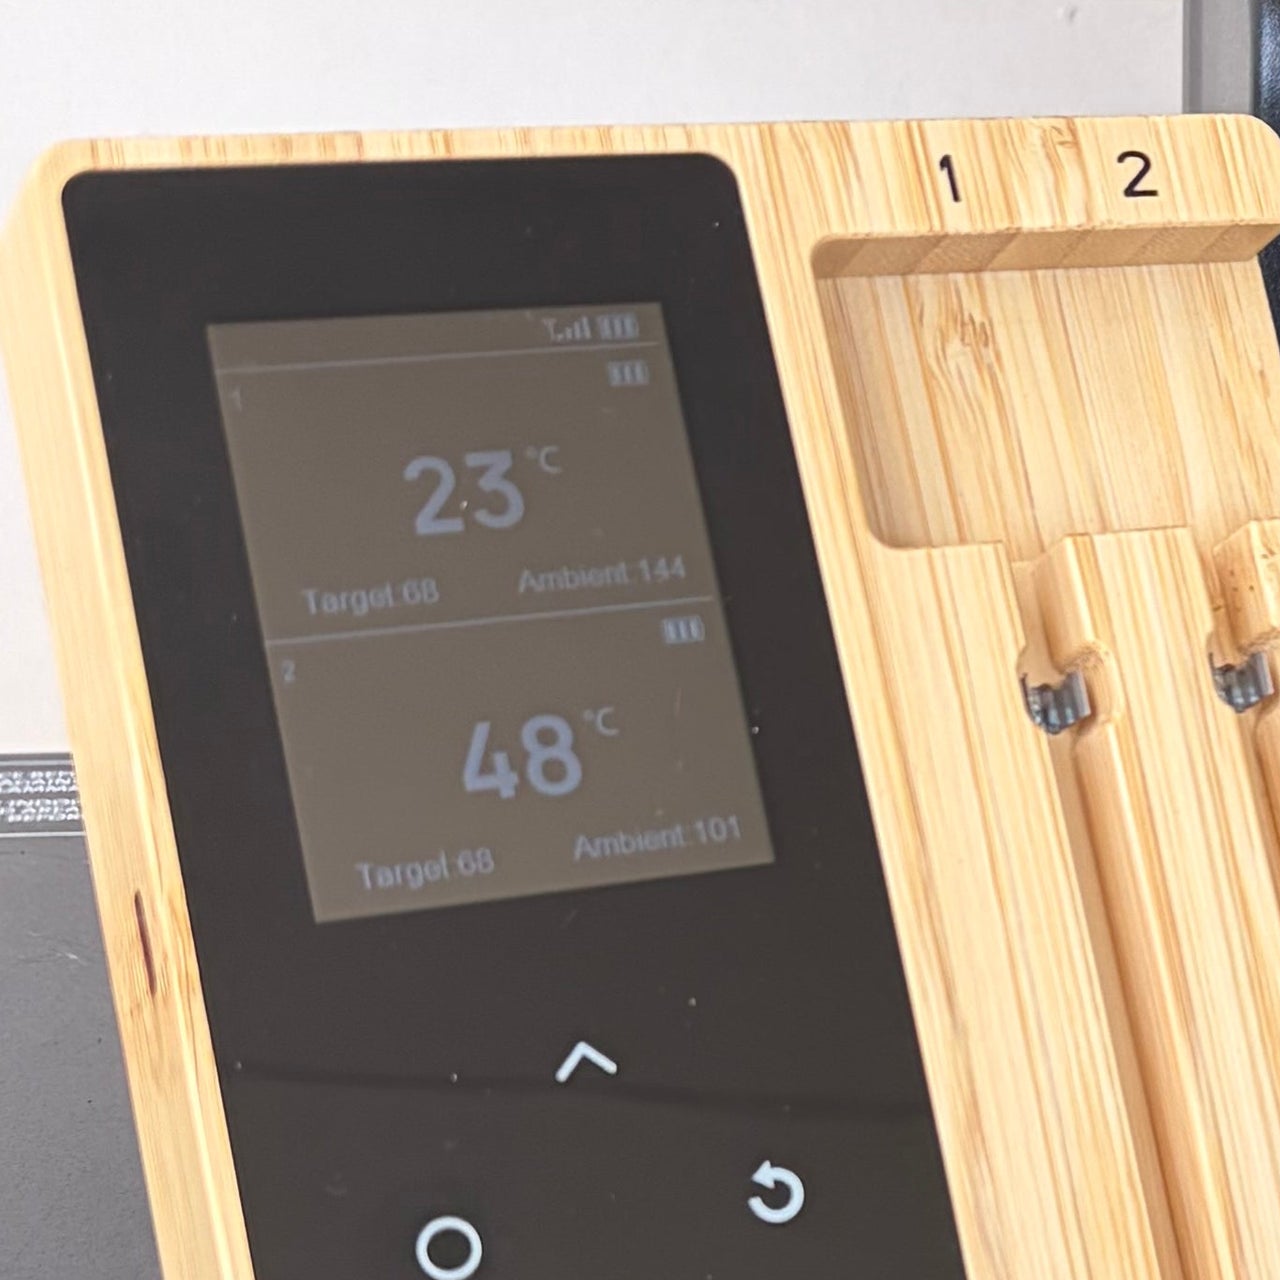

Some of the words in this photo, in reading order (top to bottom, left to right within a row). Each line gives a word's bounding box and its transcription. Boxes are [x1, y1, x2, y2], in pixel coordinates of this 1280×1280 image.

[940, 154, 961, 202] 1
[1117, 151, 1158, 197] 2
[404, 449, 524, 535] 23
[463, 714, 582, 799] 48
